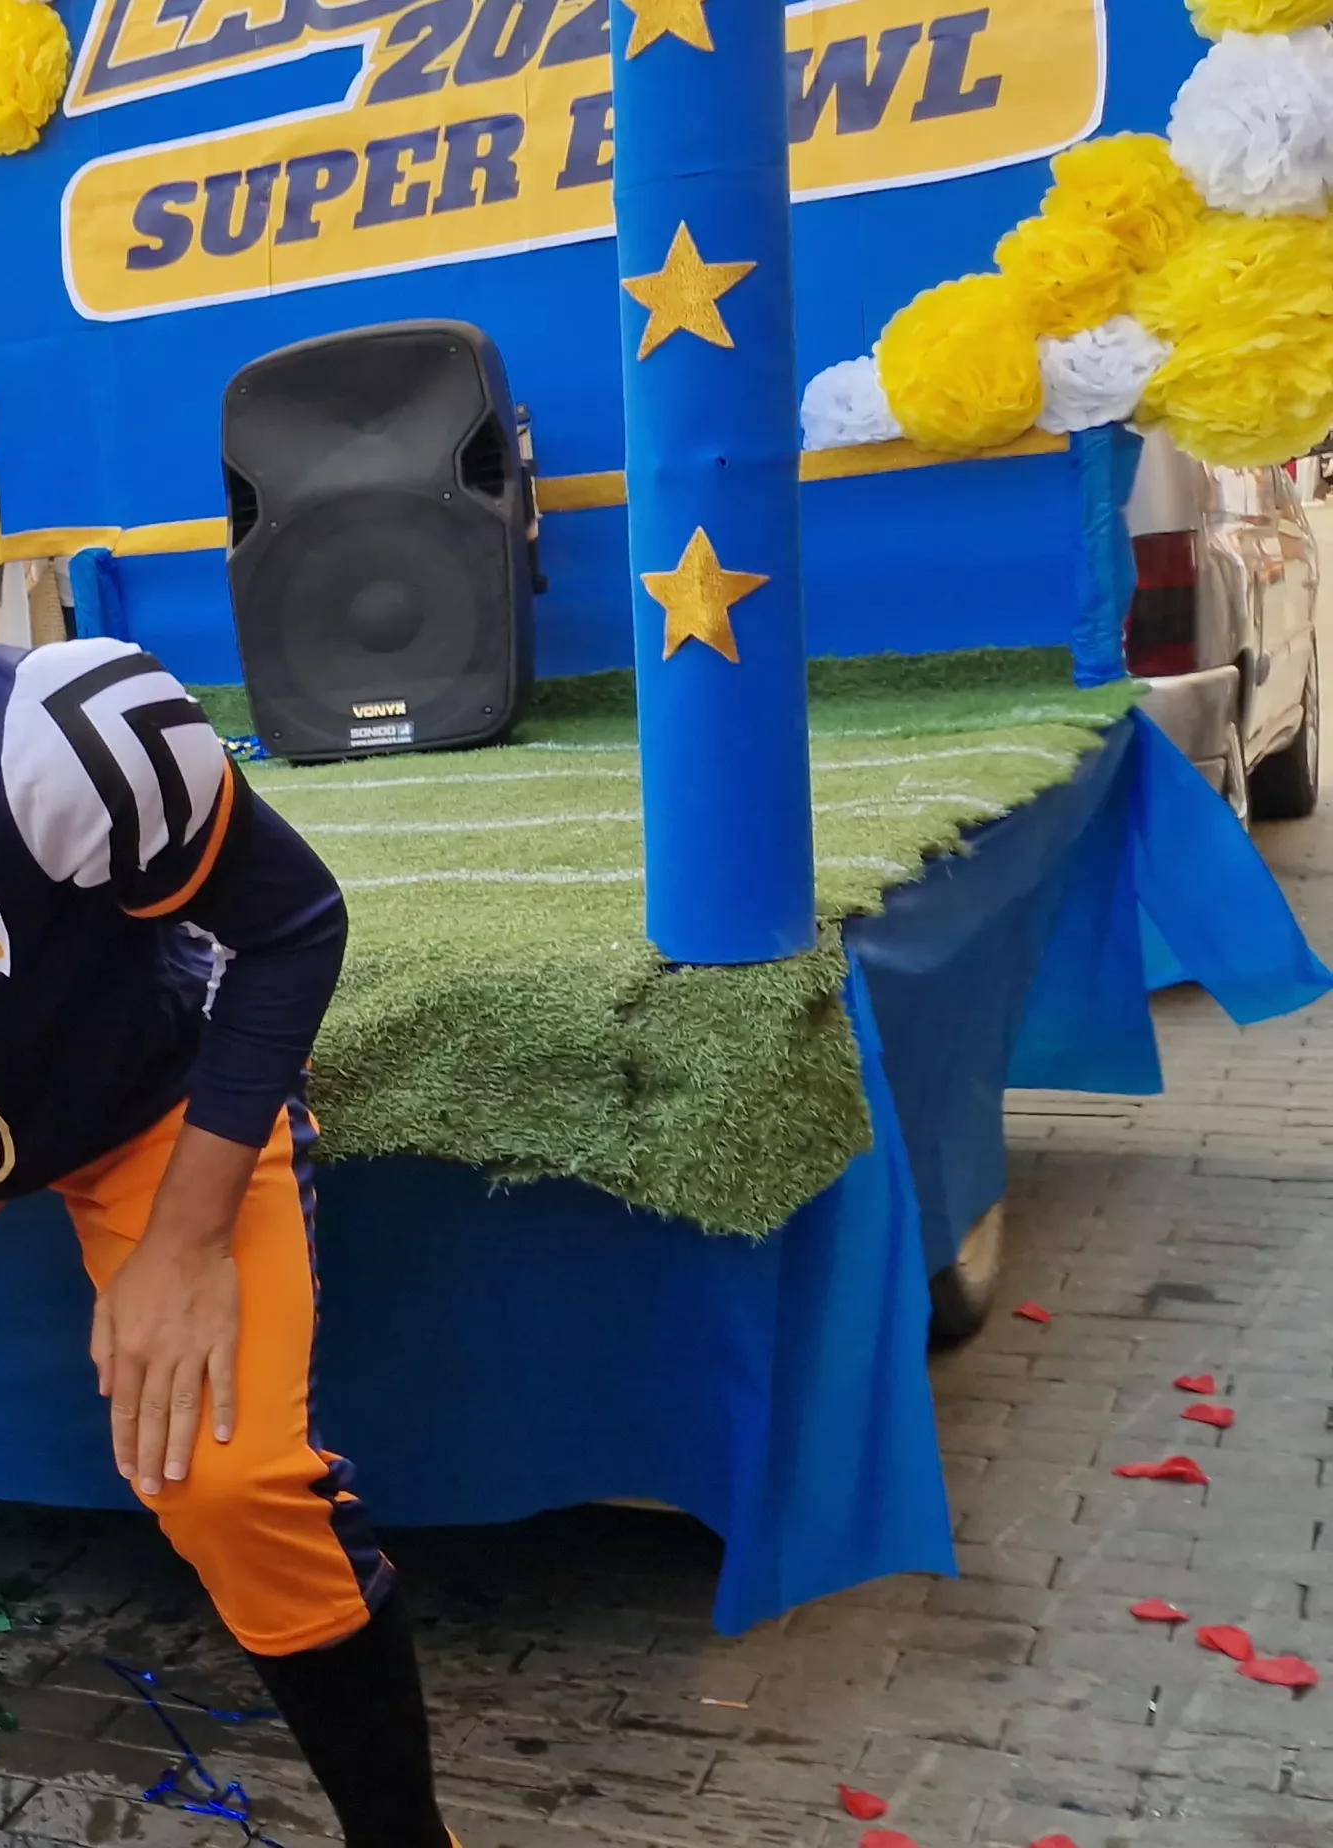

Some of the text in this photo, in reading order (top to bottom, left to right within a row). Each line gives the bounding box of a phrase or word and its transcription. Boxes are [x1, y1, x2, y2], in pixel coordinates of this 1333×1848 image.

[364, 0, 611, 104] 202
[126, 7, 1002, 271] SUPER BWL
[353, 700, 406, 718] VONYX
